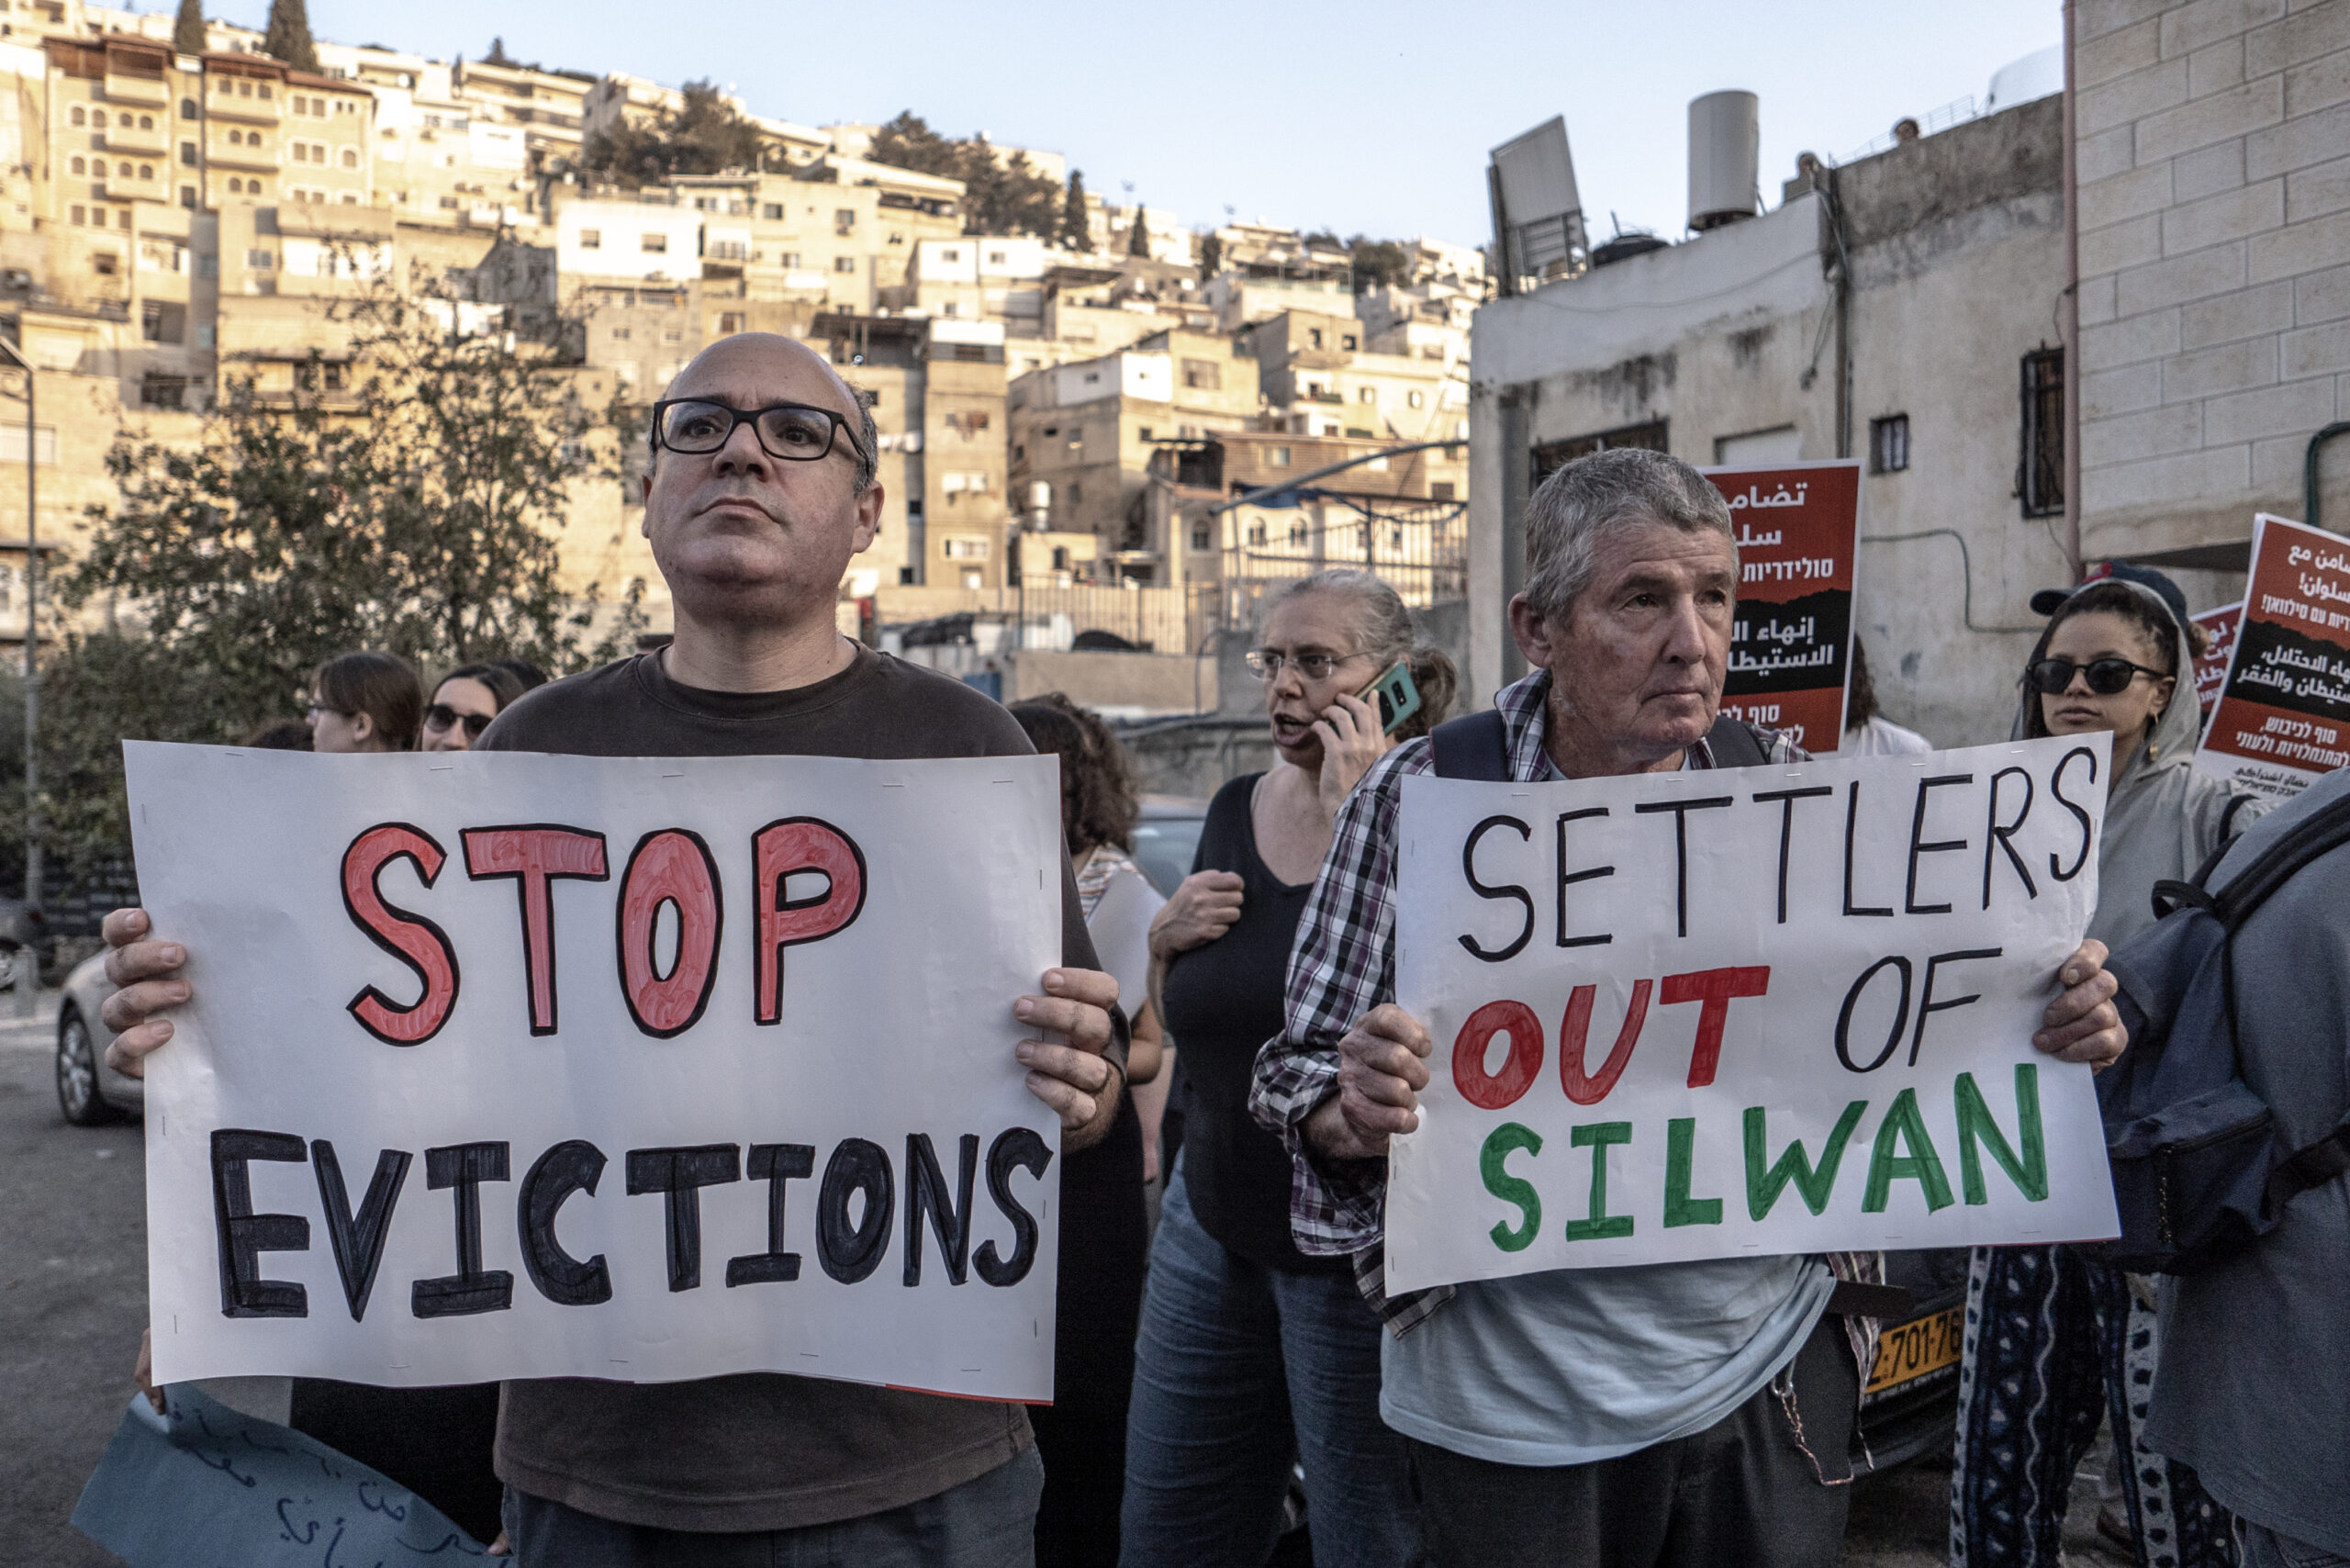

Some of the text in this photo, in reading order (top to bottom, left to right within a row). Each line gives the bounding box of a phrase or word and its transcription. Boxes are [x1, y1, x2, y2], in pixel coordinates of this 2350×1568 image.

[1726, 482, 1808, 510] تضام
[2287, 544, 2311, 566] مع
[1742, 557, 1834, 583] סולידריות
[2309, 606, 2327, 625] עם
[1756, 616, 1814, 645] إنهاء
[1727, 644, 1834, 678] الاستيطا
[1748, 704, 1780, 725] סוף
[2313, 726, 2338, 745] סוף
[1457, 745, 2098, 964] SETTLERS
[340, 815, 867, 1047] STOP
[1450, 946, 2004, 1111] OUT OF
[1478, 1062, 2049, 1254] SILWAN
[209, 1126, 1054, 1324] EVICTIONS
